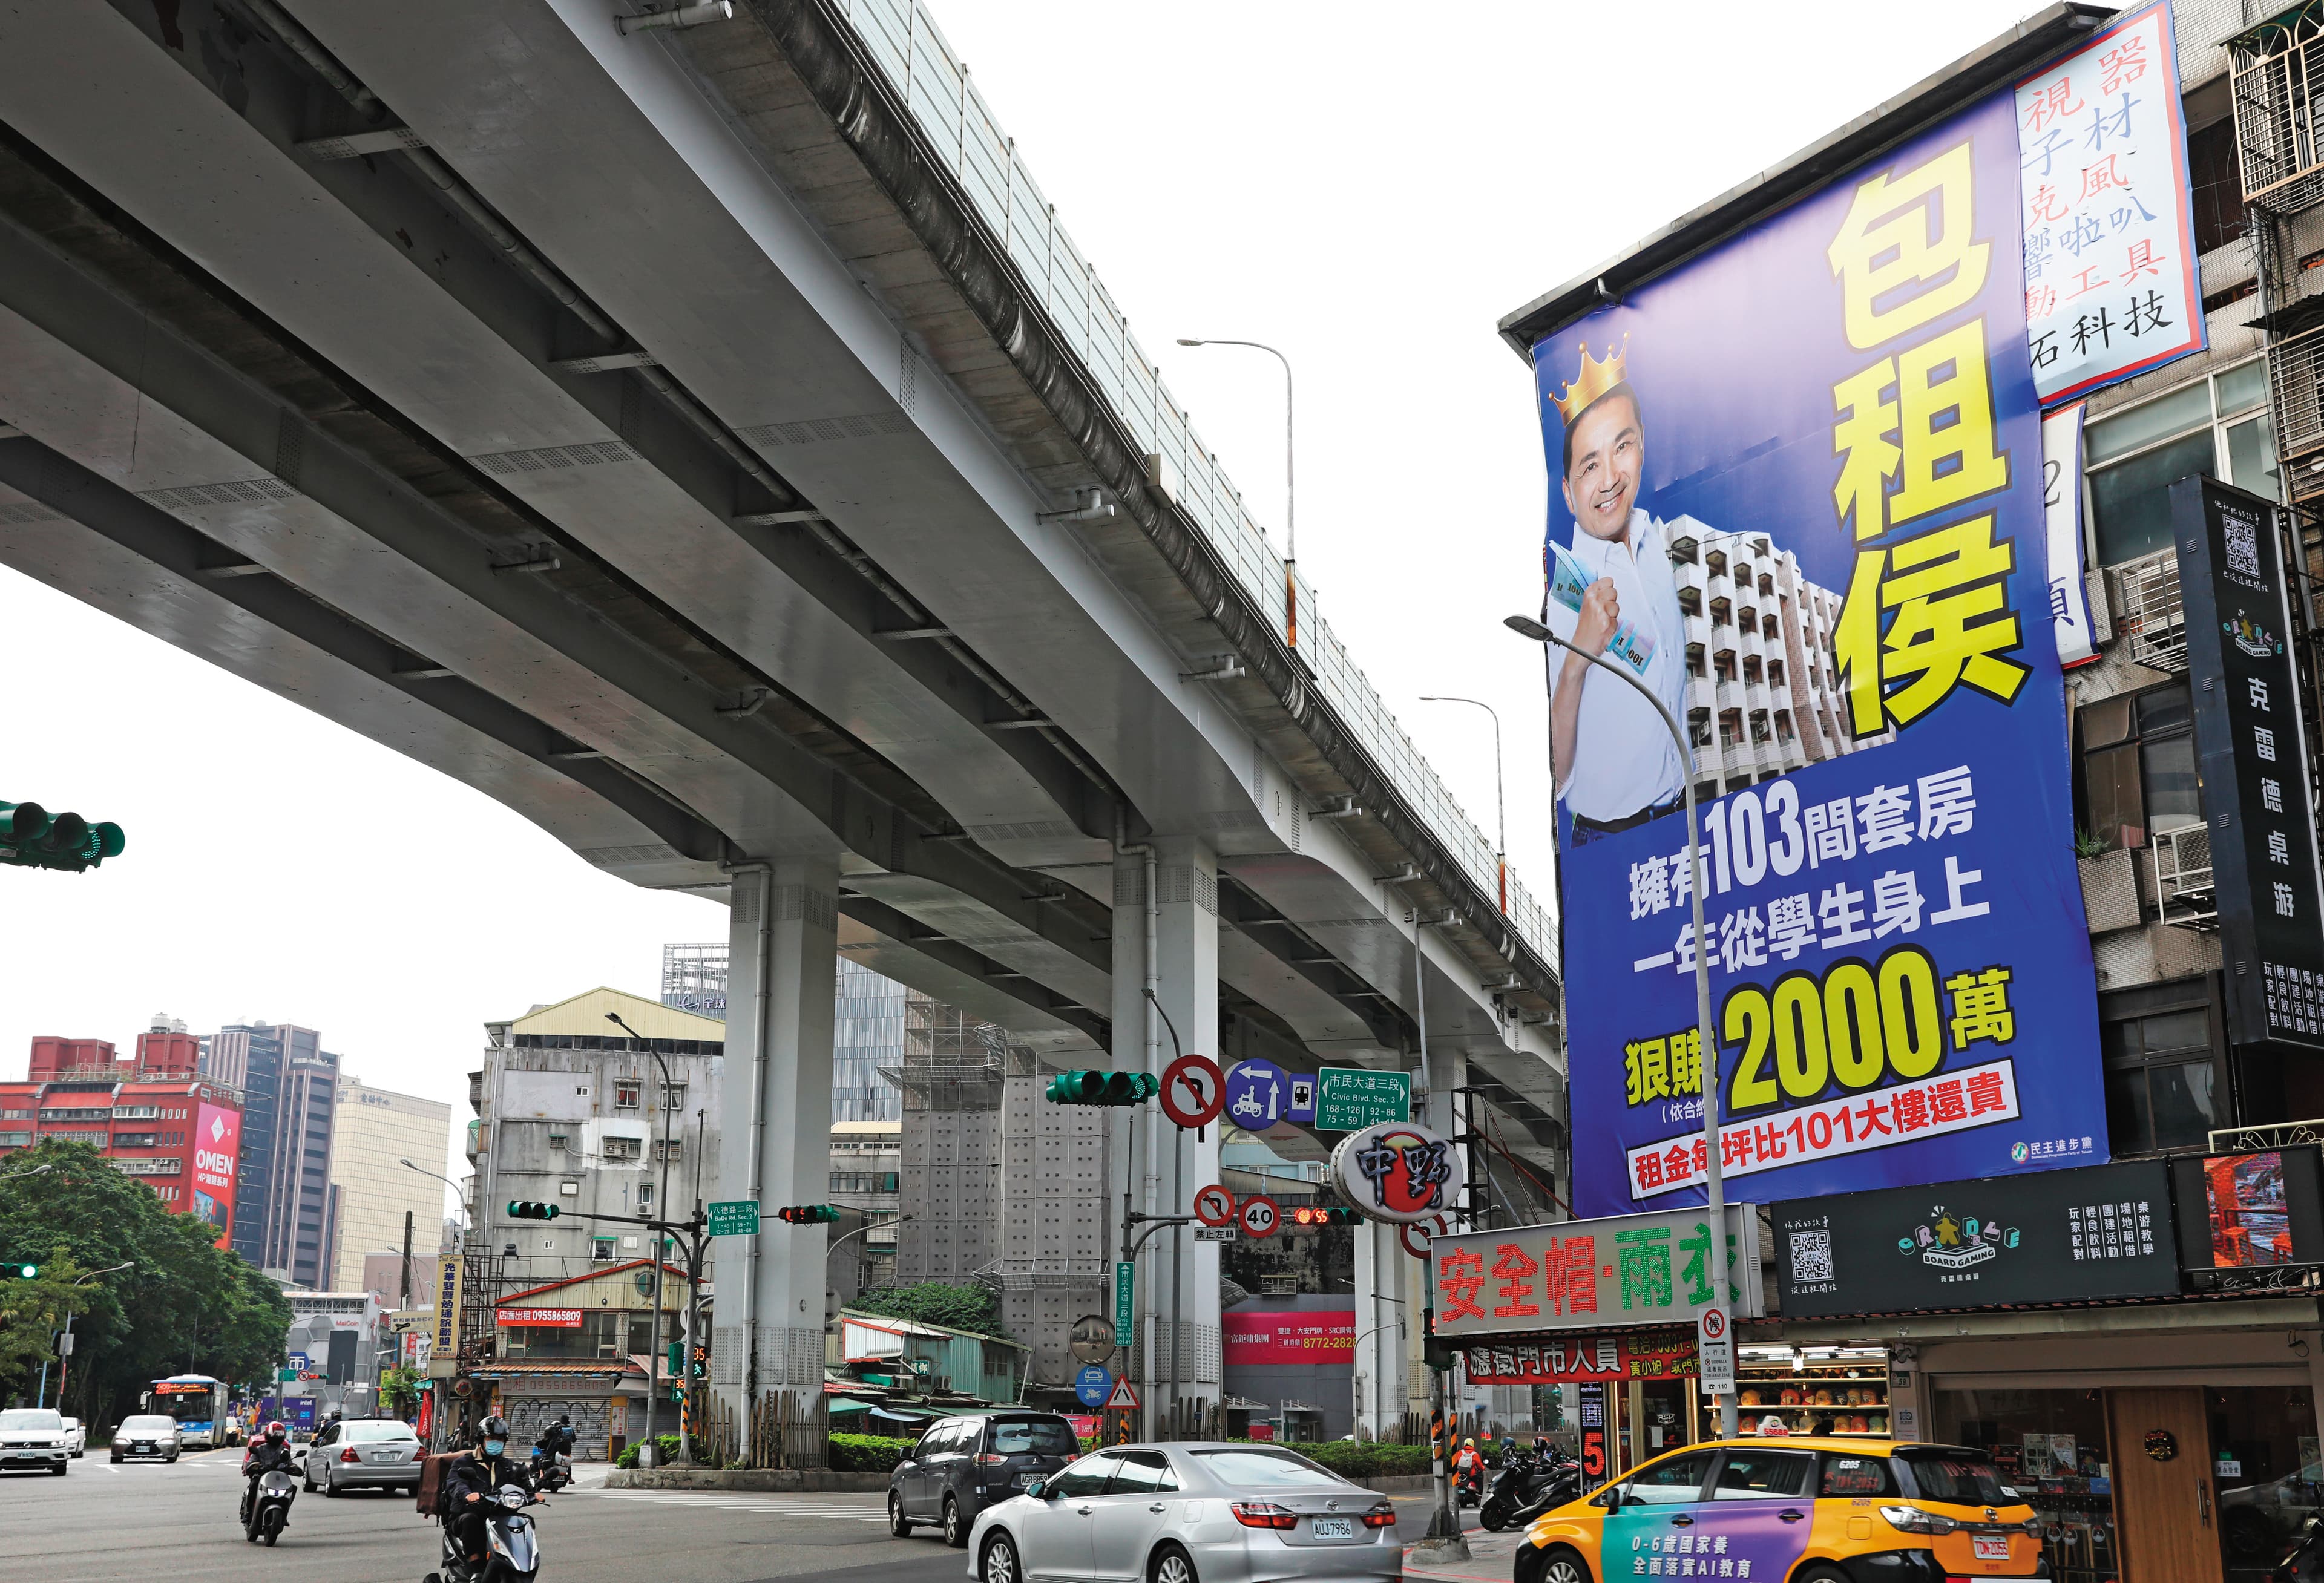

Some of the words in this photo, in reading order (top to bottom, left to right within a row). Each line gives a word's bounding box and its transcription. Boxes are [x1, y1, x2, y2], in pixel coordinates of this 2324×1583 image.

[1828, 140, 2029, 734] 包租侯
[2247, 676, 2295, 918] 克雷德桌游
[1633, 856, 1991, 975] 一年從學生身上
[2263, 961, 2279, 1027] 玩家配對
[2276, 964, 2292, 1030] 輕食飲料
[2289, 967, 2305, 1032] 團建活動
[2302, 969, 2318, 1035] 場地租借
[1330, 1074, 1400, 1091] 市民大道三段
[1325, 1104, 1361, 1115] 168-126
[1370, 1107, 1396, 1116] 92-86
[2030, 1136, 2092, 1155] 民主進步黨
[196, 1149, 234, 1176] OMEN
[713, 1204, 754, 1215] 八德路二段
[1247, 1209, 1272, 1224] 40
[1196, 1230, 1234, 1239] 禁止左轉
[2068, 1207, 2084, 1260] 玩家配對
[2085, 1205, 2101, 1259] 輕食飲料
[2102, 1204, 2119, 1259] 團建活動
[2120, 1202, 2136, 1257] 場地租借
[2138, 1201, 2154, 1256] 桌游教學
[1925, 1255, 1956, 1267] BOARD
[1958, 1249, 1994, 1266] GAMING
[1121, 1270, 1129, 1317] 市民大道三段
[499, 1310, 531, 1320] 店面出租
[533, 1309, 581, 1322] 0955865809
[694, 1348, 705, 1360] 35
[1630, 1360, 1662, 1377] 黃小姐
[501, 1377, 525, 1391] 出租
[676, 1379, 685, 1389] 35
[1839, 1460, 1860, 1469] 6205
[1633, 1556, 1752, 1579] 全面落實AI教育
